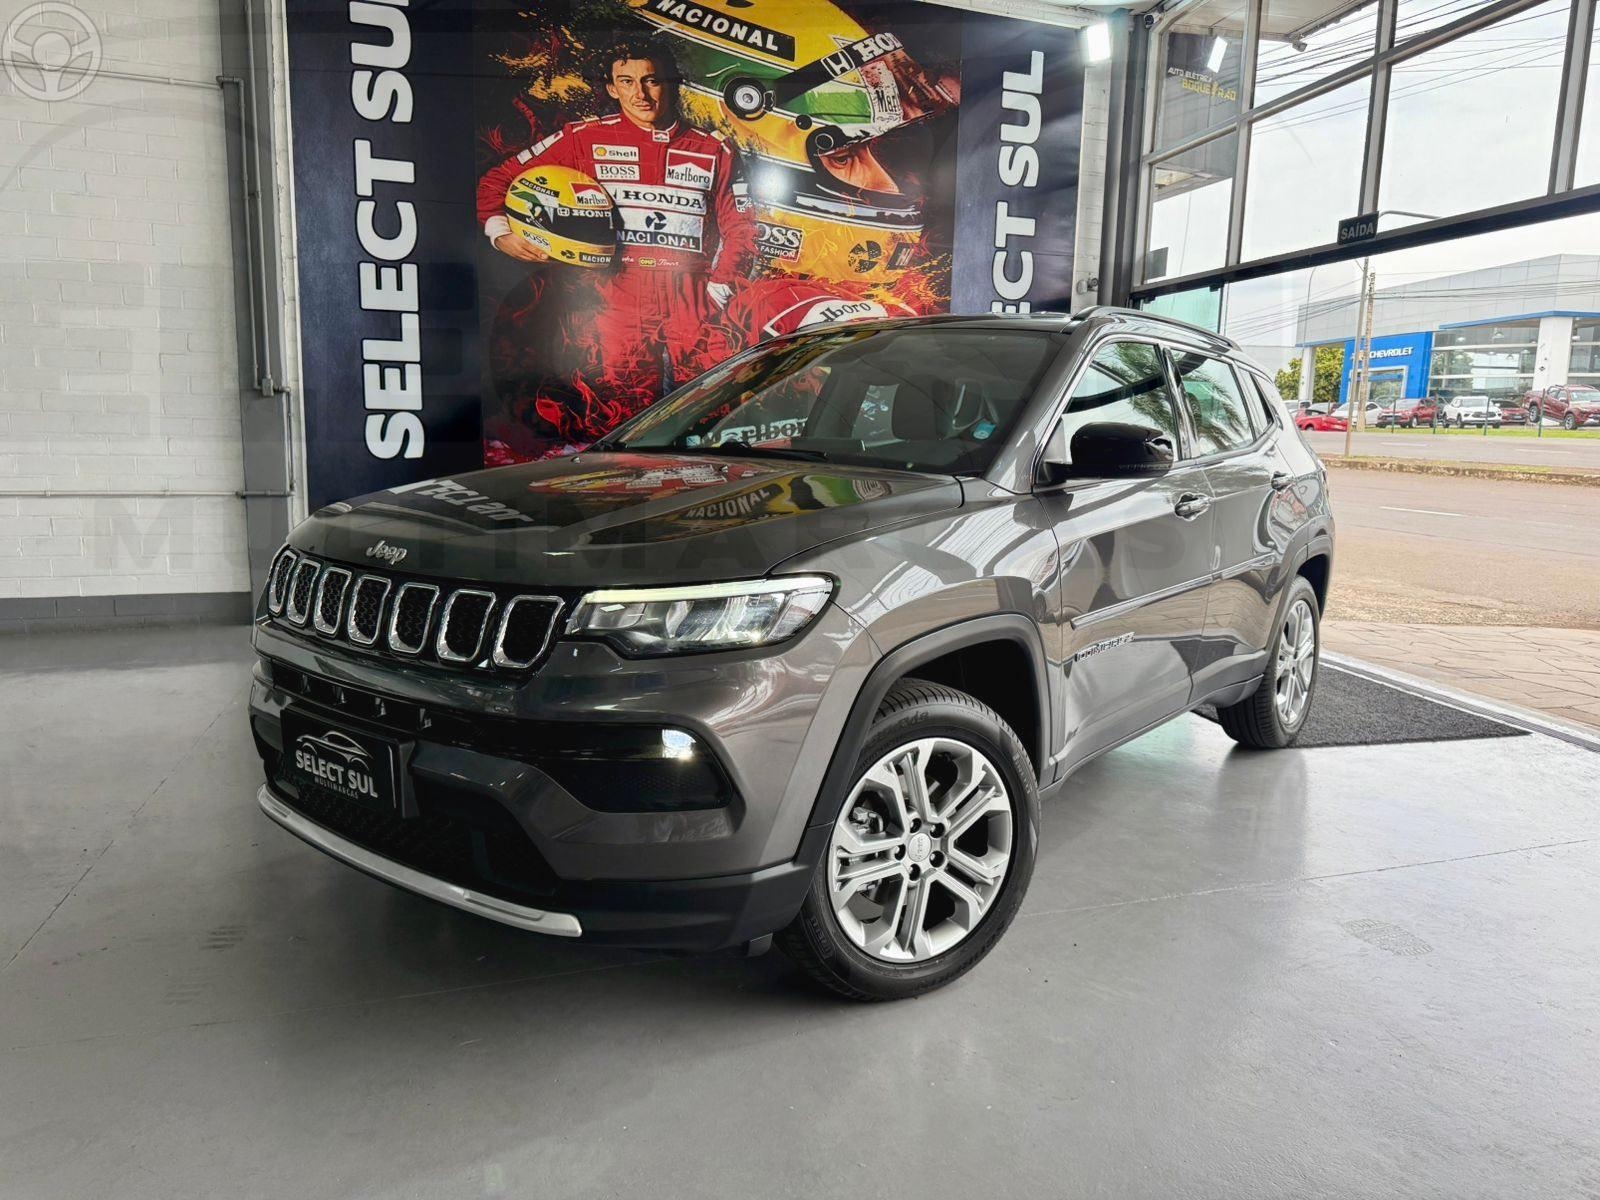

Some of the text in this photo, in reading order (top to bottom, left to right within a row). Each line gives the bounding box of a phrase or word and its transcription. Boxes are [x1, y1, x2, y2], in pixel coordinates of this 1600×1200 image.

[655, 0, 779, 52] NACIONAL
[998, 50, 1045, 187] SUL
[608, 149, 637, 158] Shell
[600, 165, 636, 176] BOSS
[666, 166, 711, 184] Marlboro
[521, 178, 556, 197] NACIONAL
[622, 189, 703, 210] HONDA
[349, 0, 425, 460] SELECT SU
[1340, 222, 1374, 240] SAÍDA
[760, 245, 797, 258] FASHION
[1369, 346, 1414, 359] CHEVROLET
[366, 540, 408, 565] Jeep
[295, 749, 378, 799] SELECT SUL
